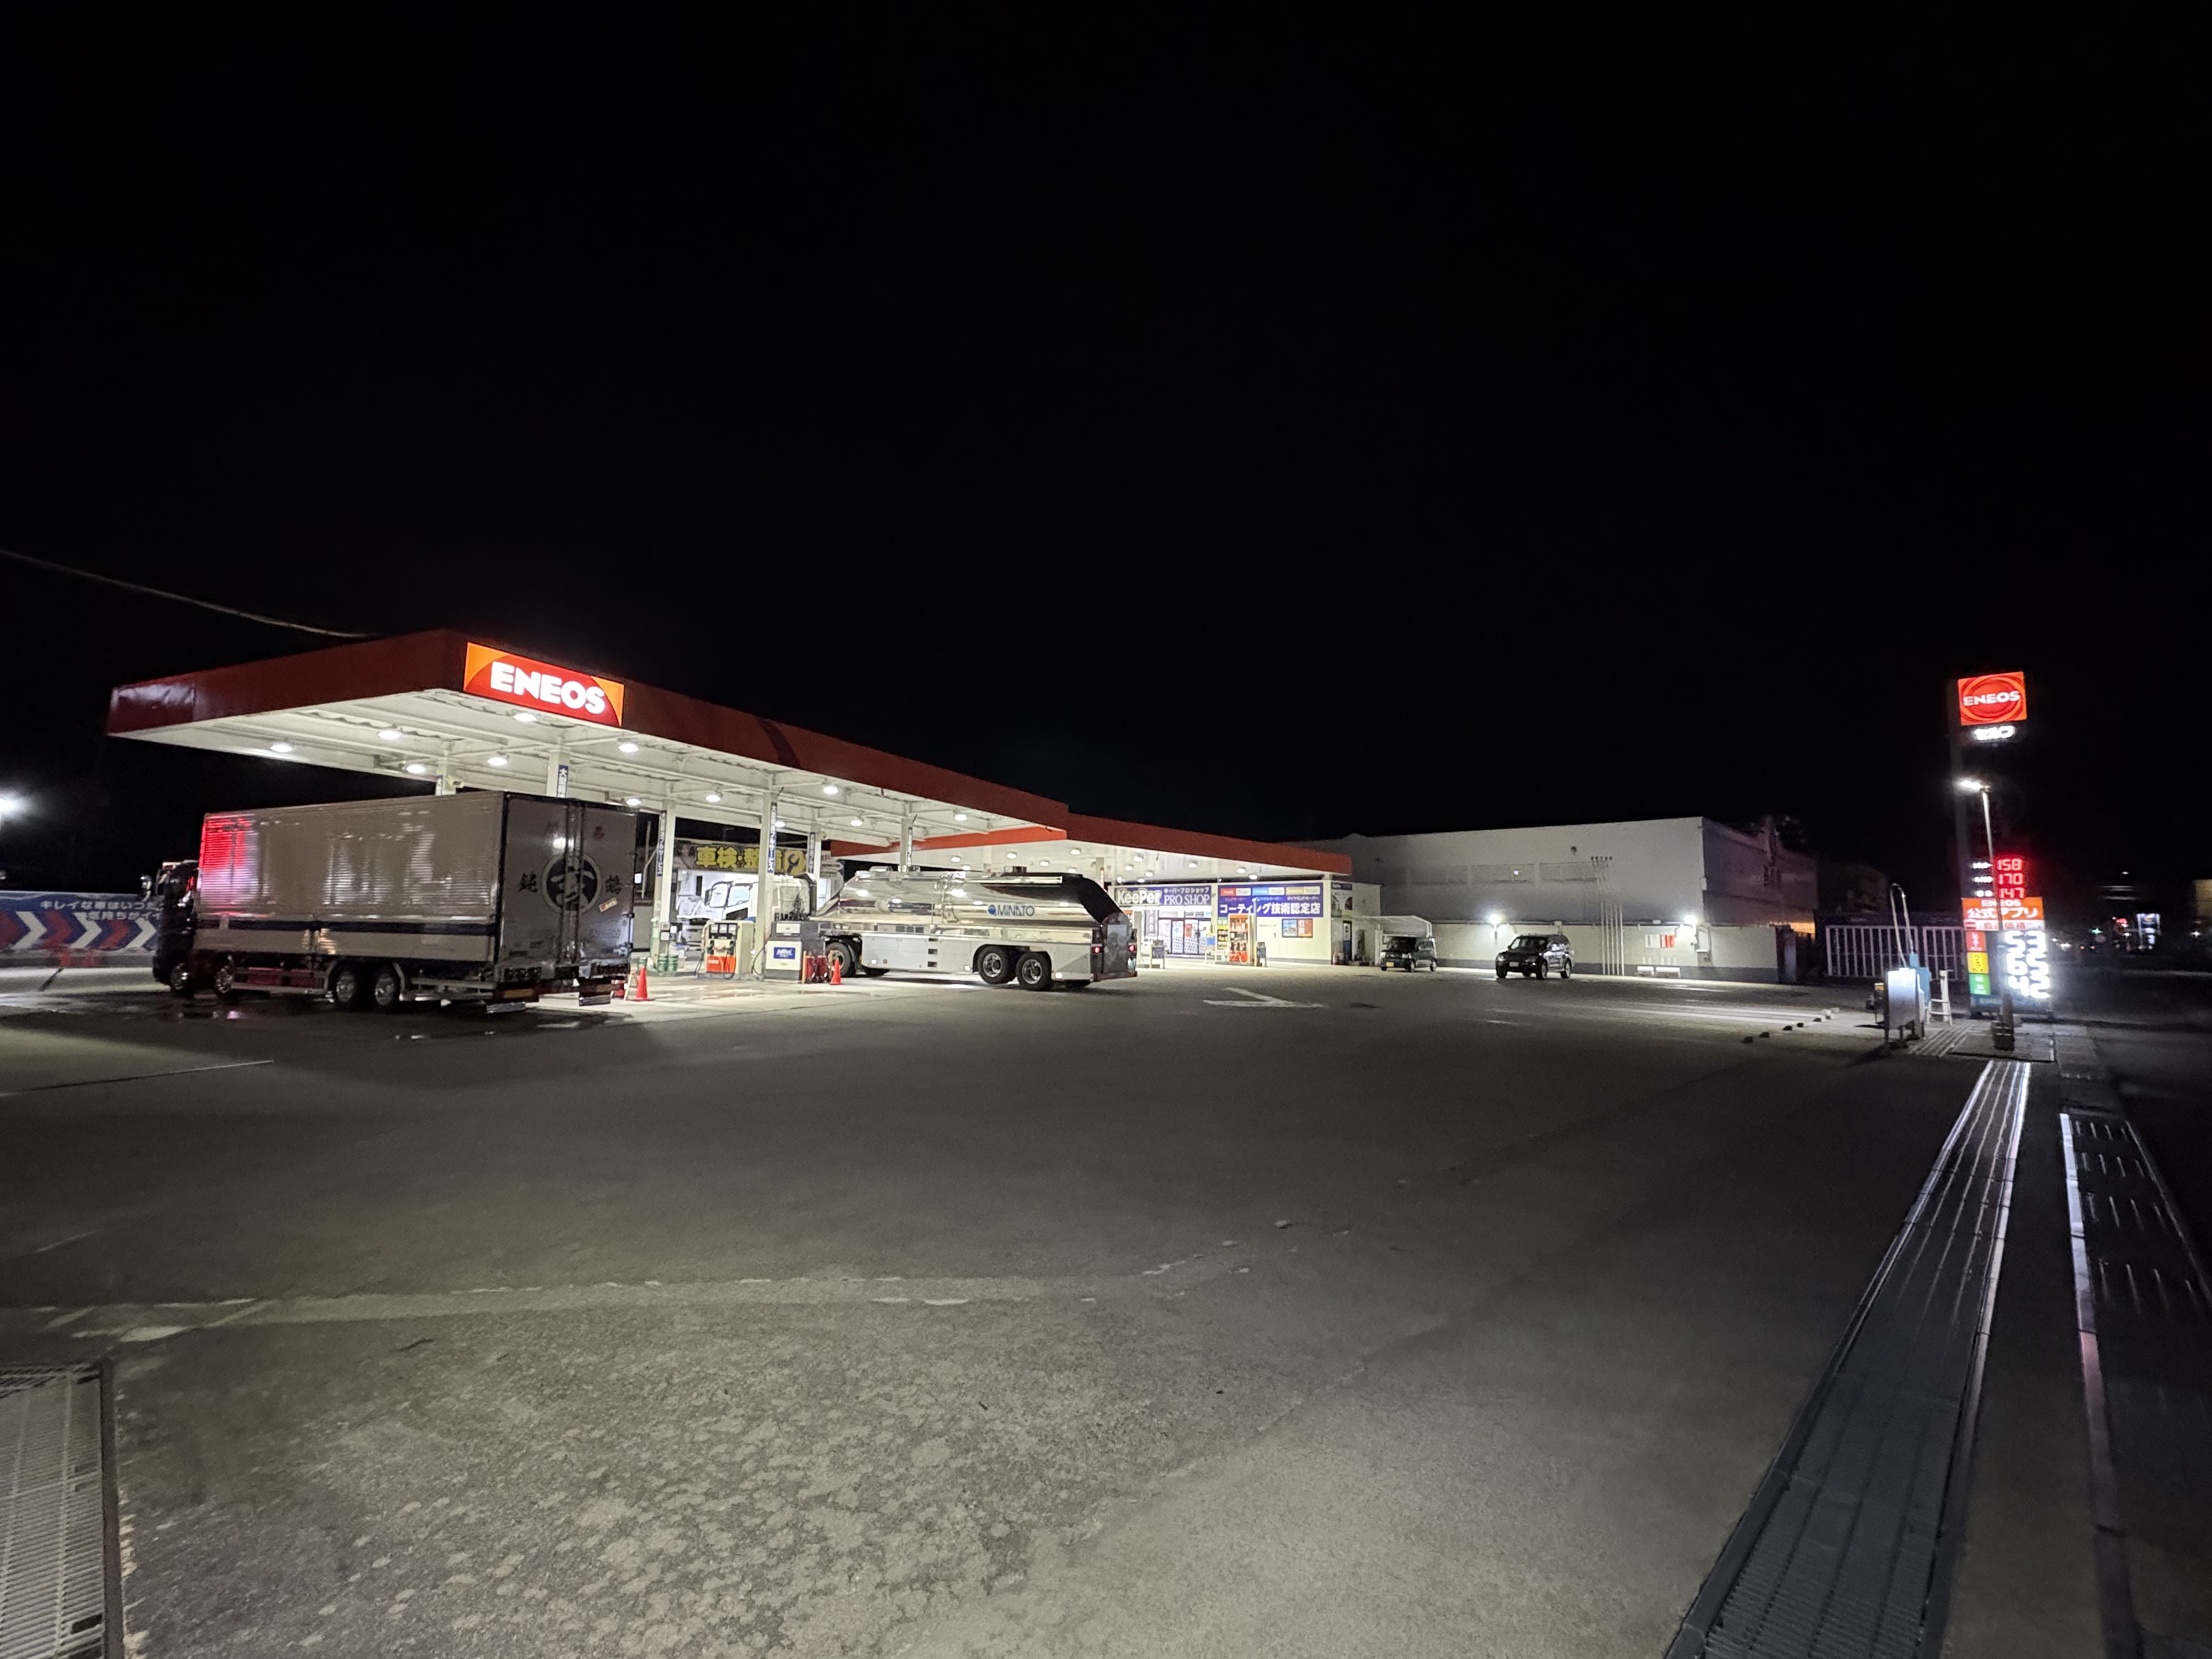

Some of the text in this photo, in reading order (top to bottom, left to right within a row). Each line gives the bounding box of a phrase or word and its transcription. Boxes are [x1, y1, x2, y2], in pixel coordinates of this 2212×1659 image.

[490, 661, 605, 714] ENEOS
[1962, 690, 2021, 707] ENEOS
[1997, 859, 2023, 871] 158
[1999, 873, 2024, 885] 170
[1117, 889, 1161, 905] KeePer
[2000, 887, 2025, 899] 147
[1164, 894, 1210, 905] PRO SHOP
[1981, 899, 2022, 907] ENEOS
[997, 904, 1035, 917] MINATO
[1966, 907, 2039, 918] 公式アプリ
